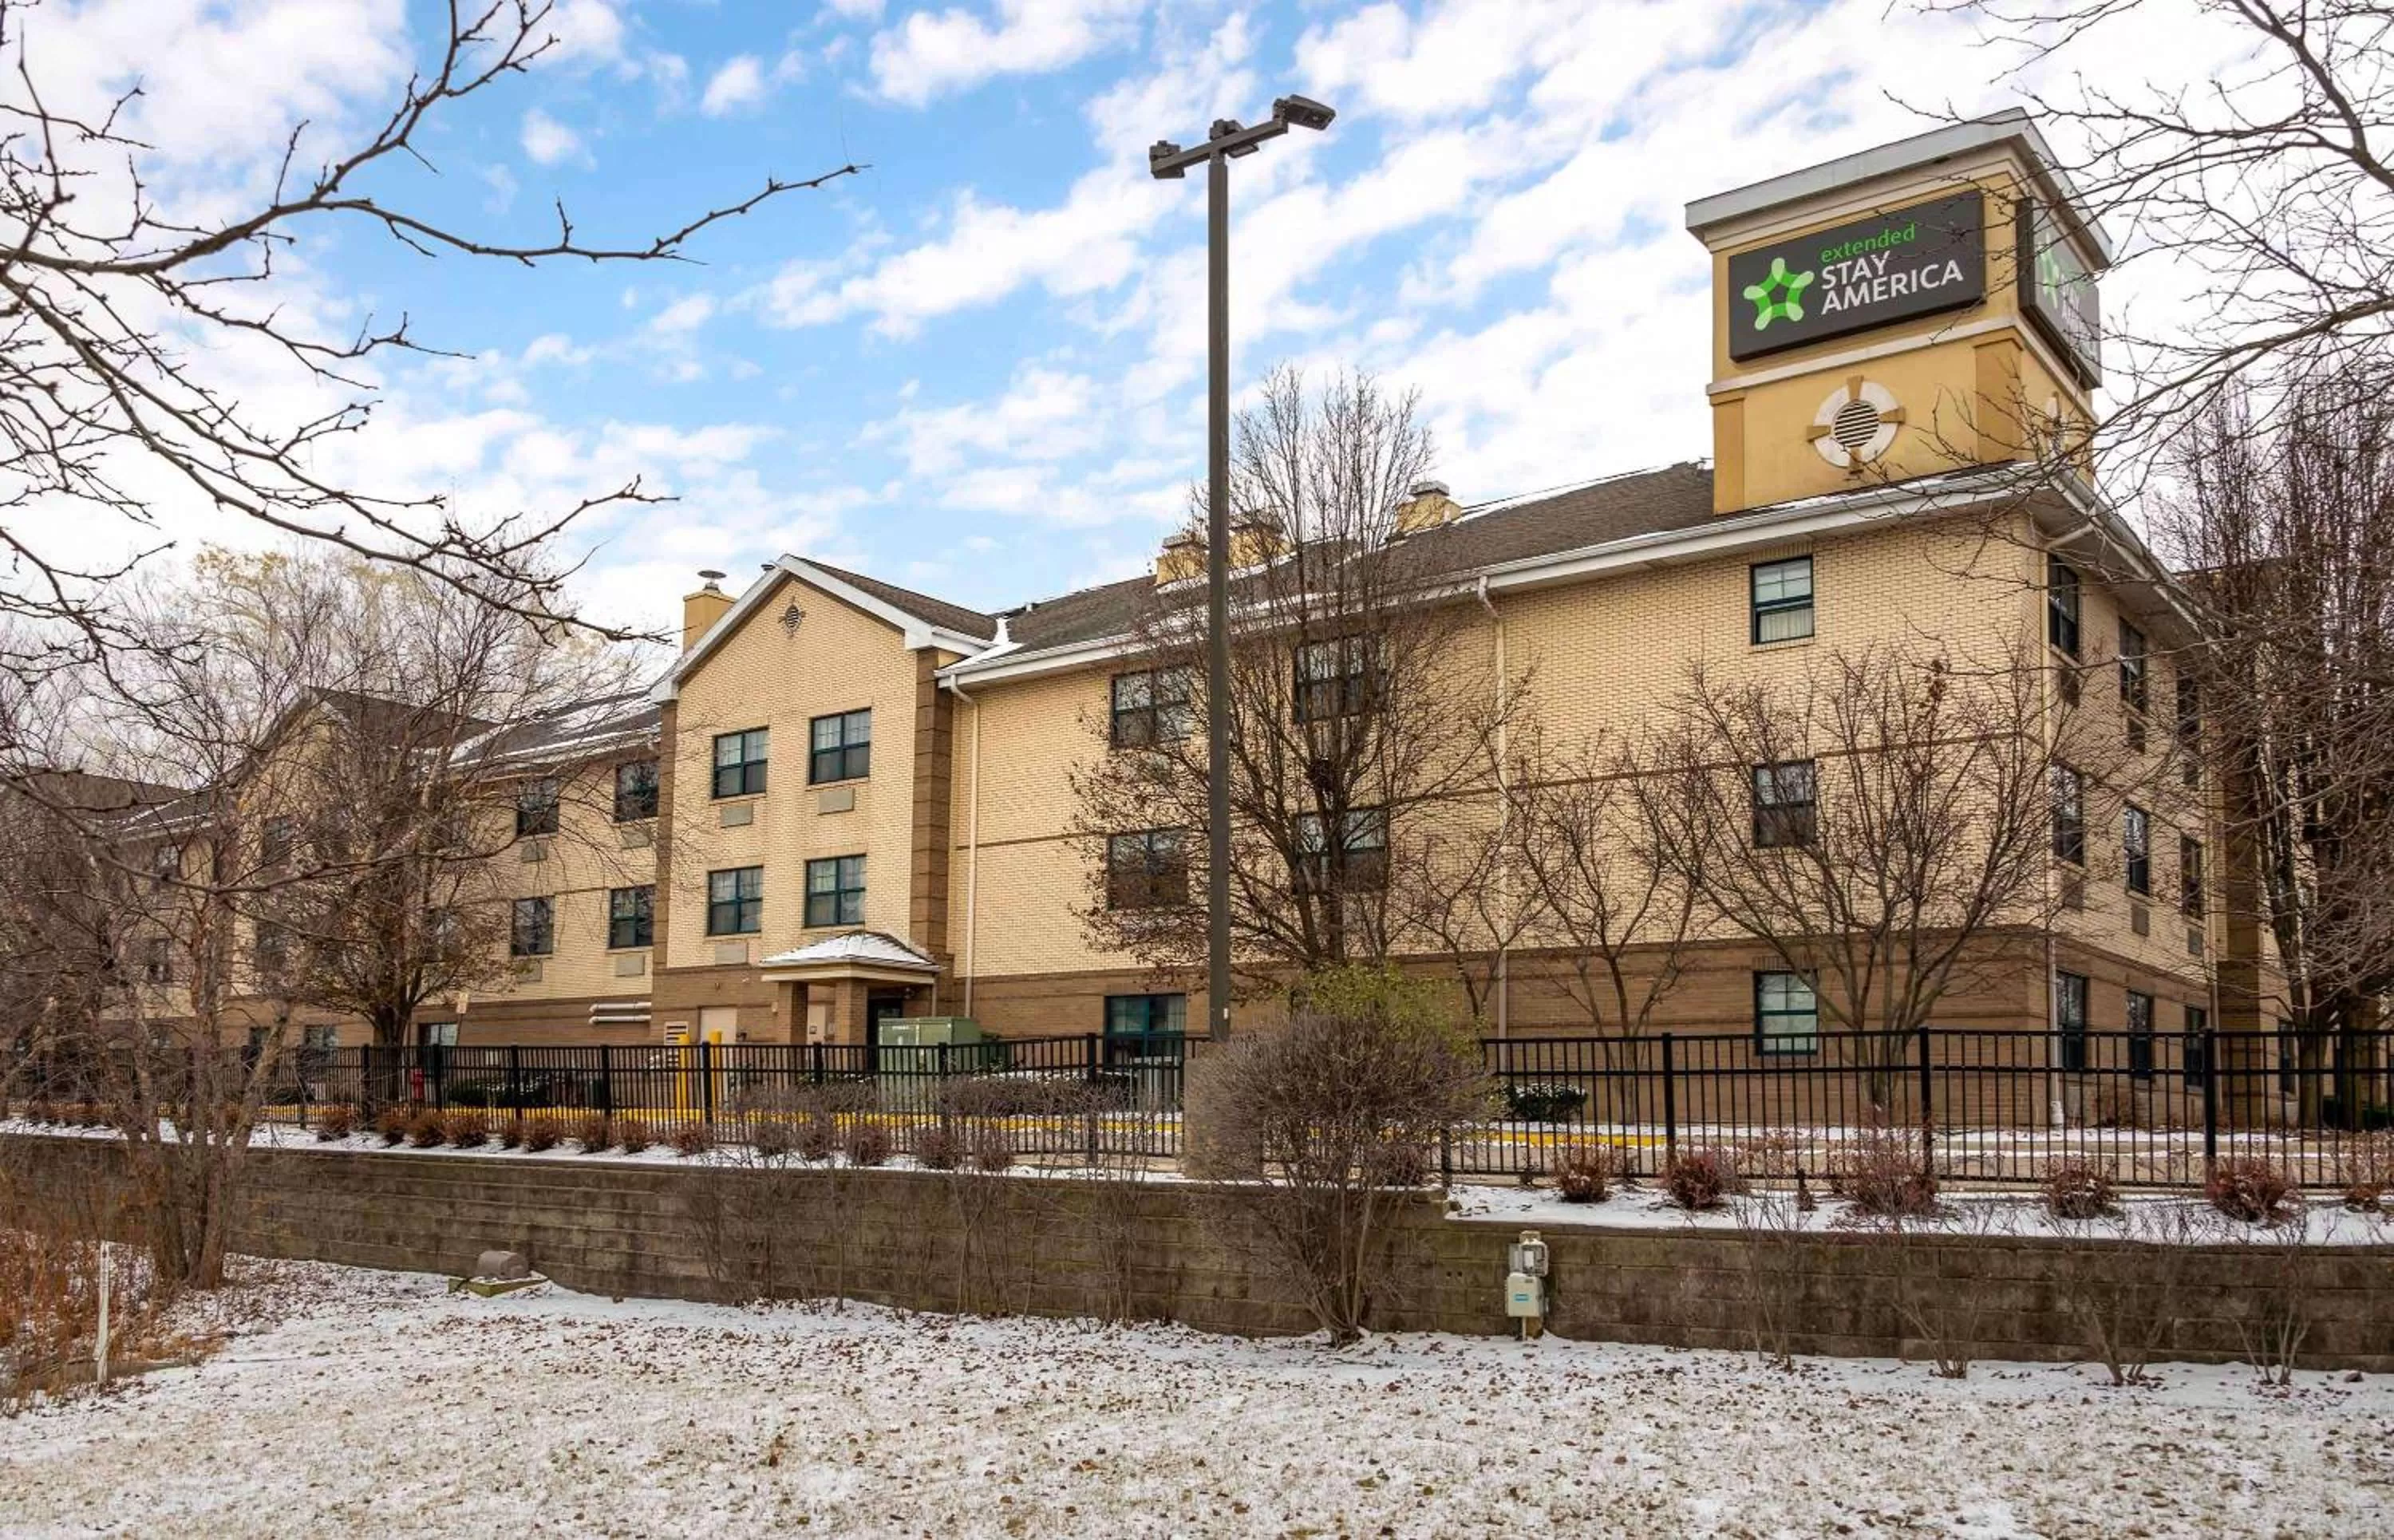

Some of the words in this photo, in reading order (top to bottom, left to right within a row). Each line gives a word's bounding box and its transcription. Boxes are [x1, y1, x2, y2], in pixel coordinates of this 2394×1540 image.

[1820, 223, 1915, 263] extended
[1821, 251, 1890, 290] STAY
[1821, 259, 1964, 315] AMERICA
